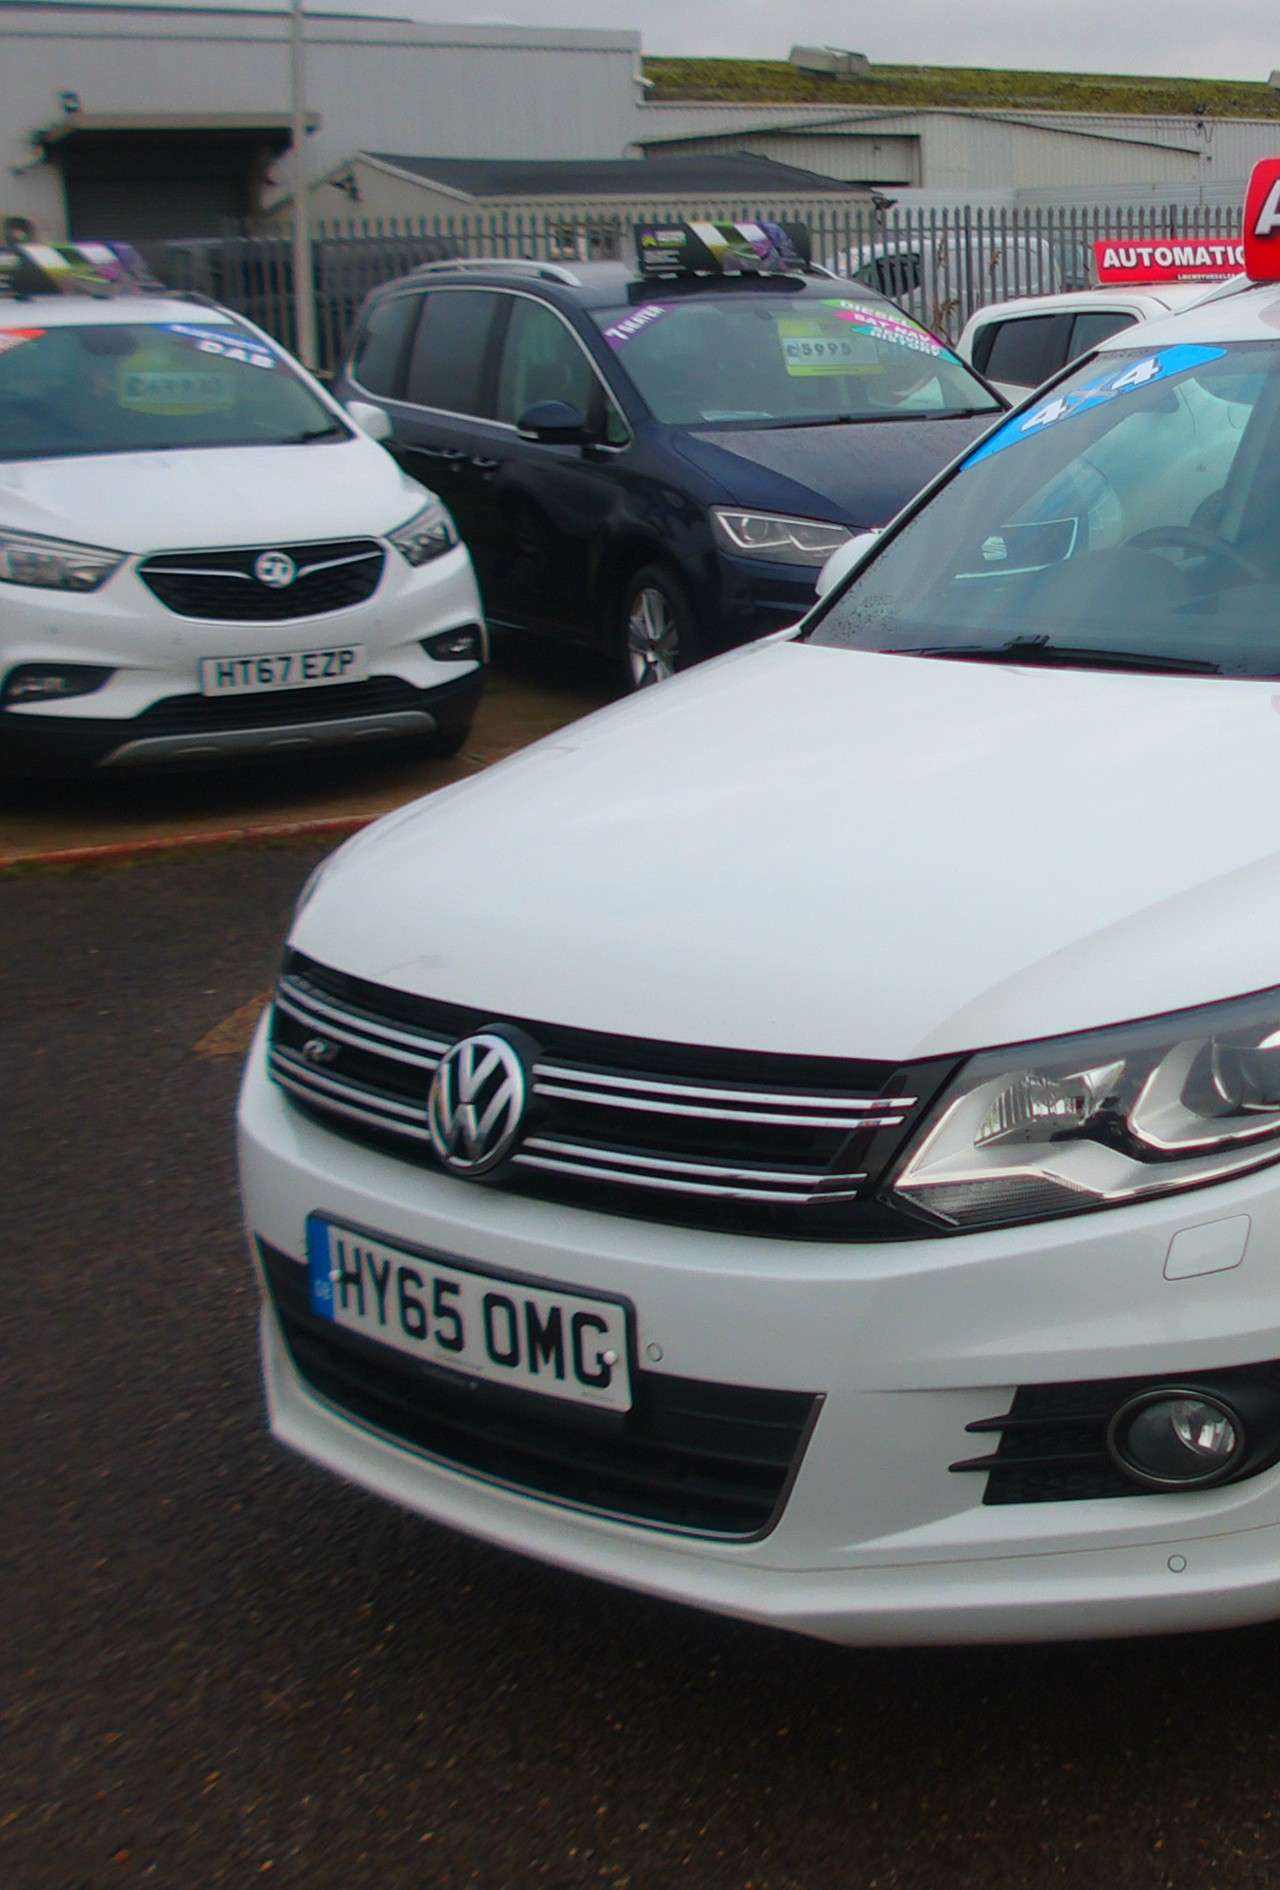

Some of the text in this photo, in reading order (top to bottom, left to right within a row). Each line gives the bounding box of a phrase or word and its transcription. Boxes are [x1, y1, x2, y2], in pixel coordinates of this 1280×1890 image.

[217, 650, 355, 688] HT67 EZP
[336, 1239, 612, 1389] HY65 OMG
